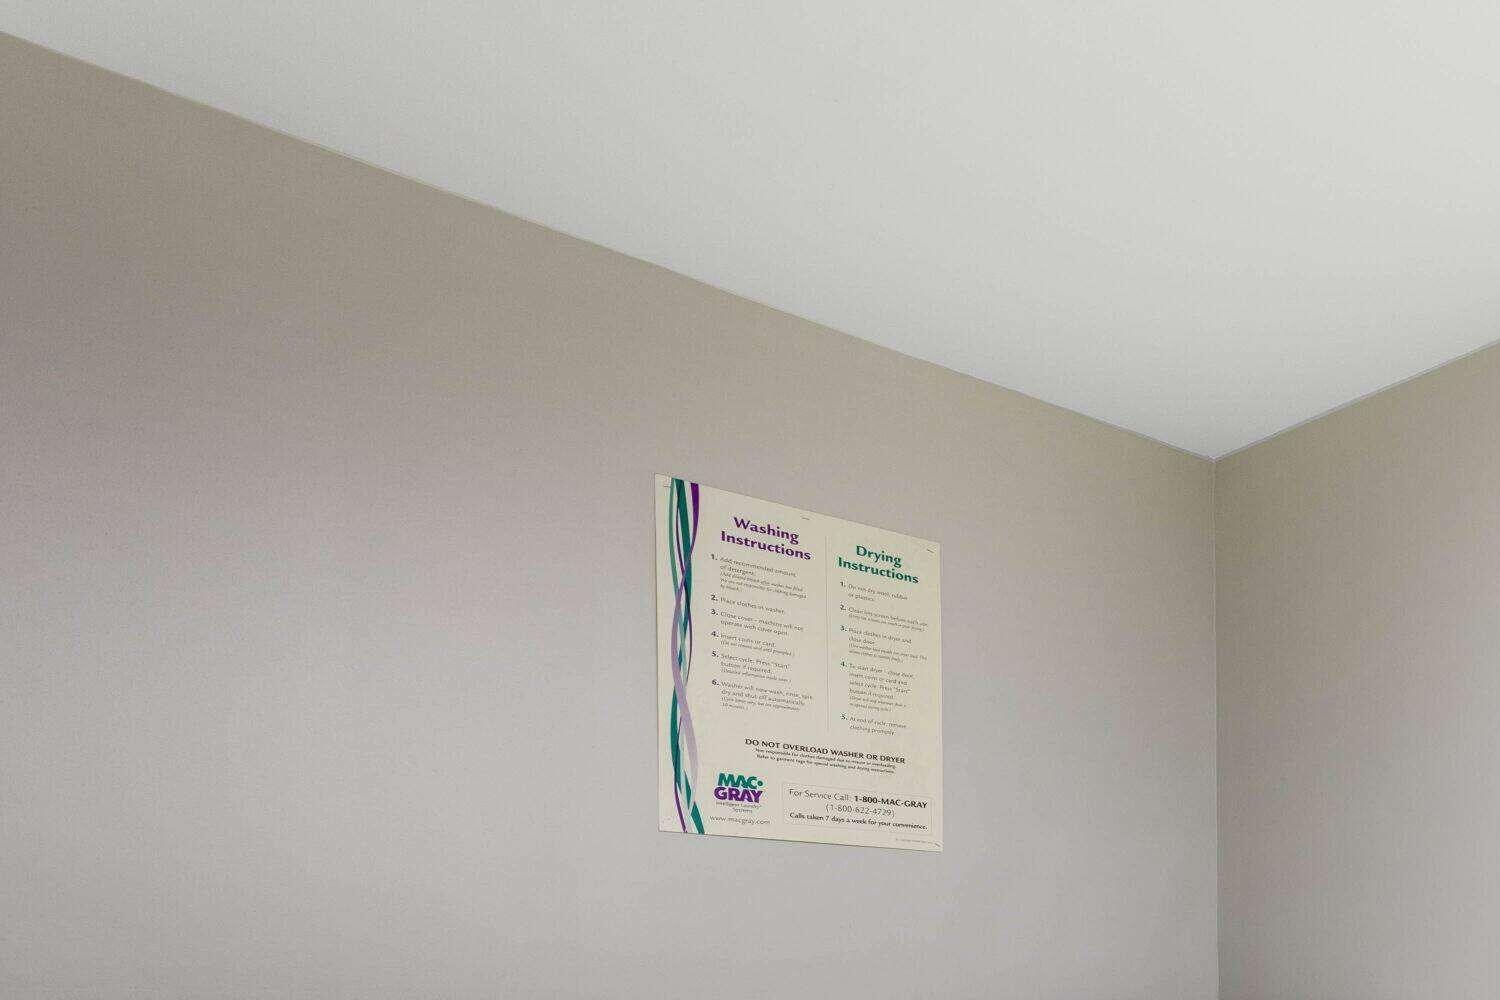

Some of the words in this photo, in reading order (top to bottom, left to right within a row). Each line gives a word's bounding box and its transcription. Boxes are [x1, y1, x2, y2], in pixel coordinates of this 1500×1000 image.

[733, 516, 799, 545] Washing
[721, 530, 812, 560] Instructions
[856, 545, 902, 568] Drying
[838, 557, 919, 584] Instructions
[761, 741, 780, 749] NOT
[782, 743, 828, 754] OVERLOAD
[830, 749, 863, 758] WASHER
[880, 755, 905, 763] DRYER
[714, 786, 763, 803] GRAY
[789, 788, 802, 796] For
[805, 790, 833, 801] Service
[854, 795, 928, 809] 1-800-MAC-GRAY
[710, 815, 770, 825] www.macgray.com
[789, 812, 805, 820] Calls
[807, 814, 824, 822] taken
[831, 816, 845, 824] days
[852, 817, 867, 825] week
[868, 818, 877, 826] for
[893, 821, 928, 830] convenience.
[826, 803, 895, 818] (1-800-622-4729)
